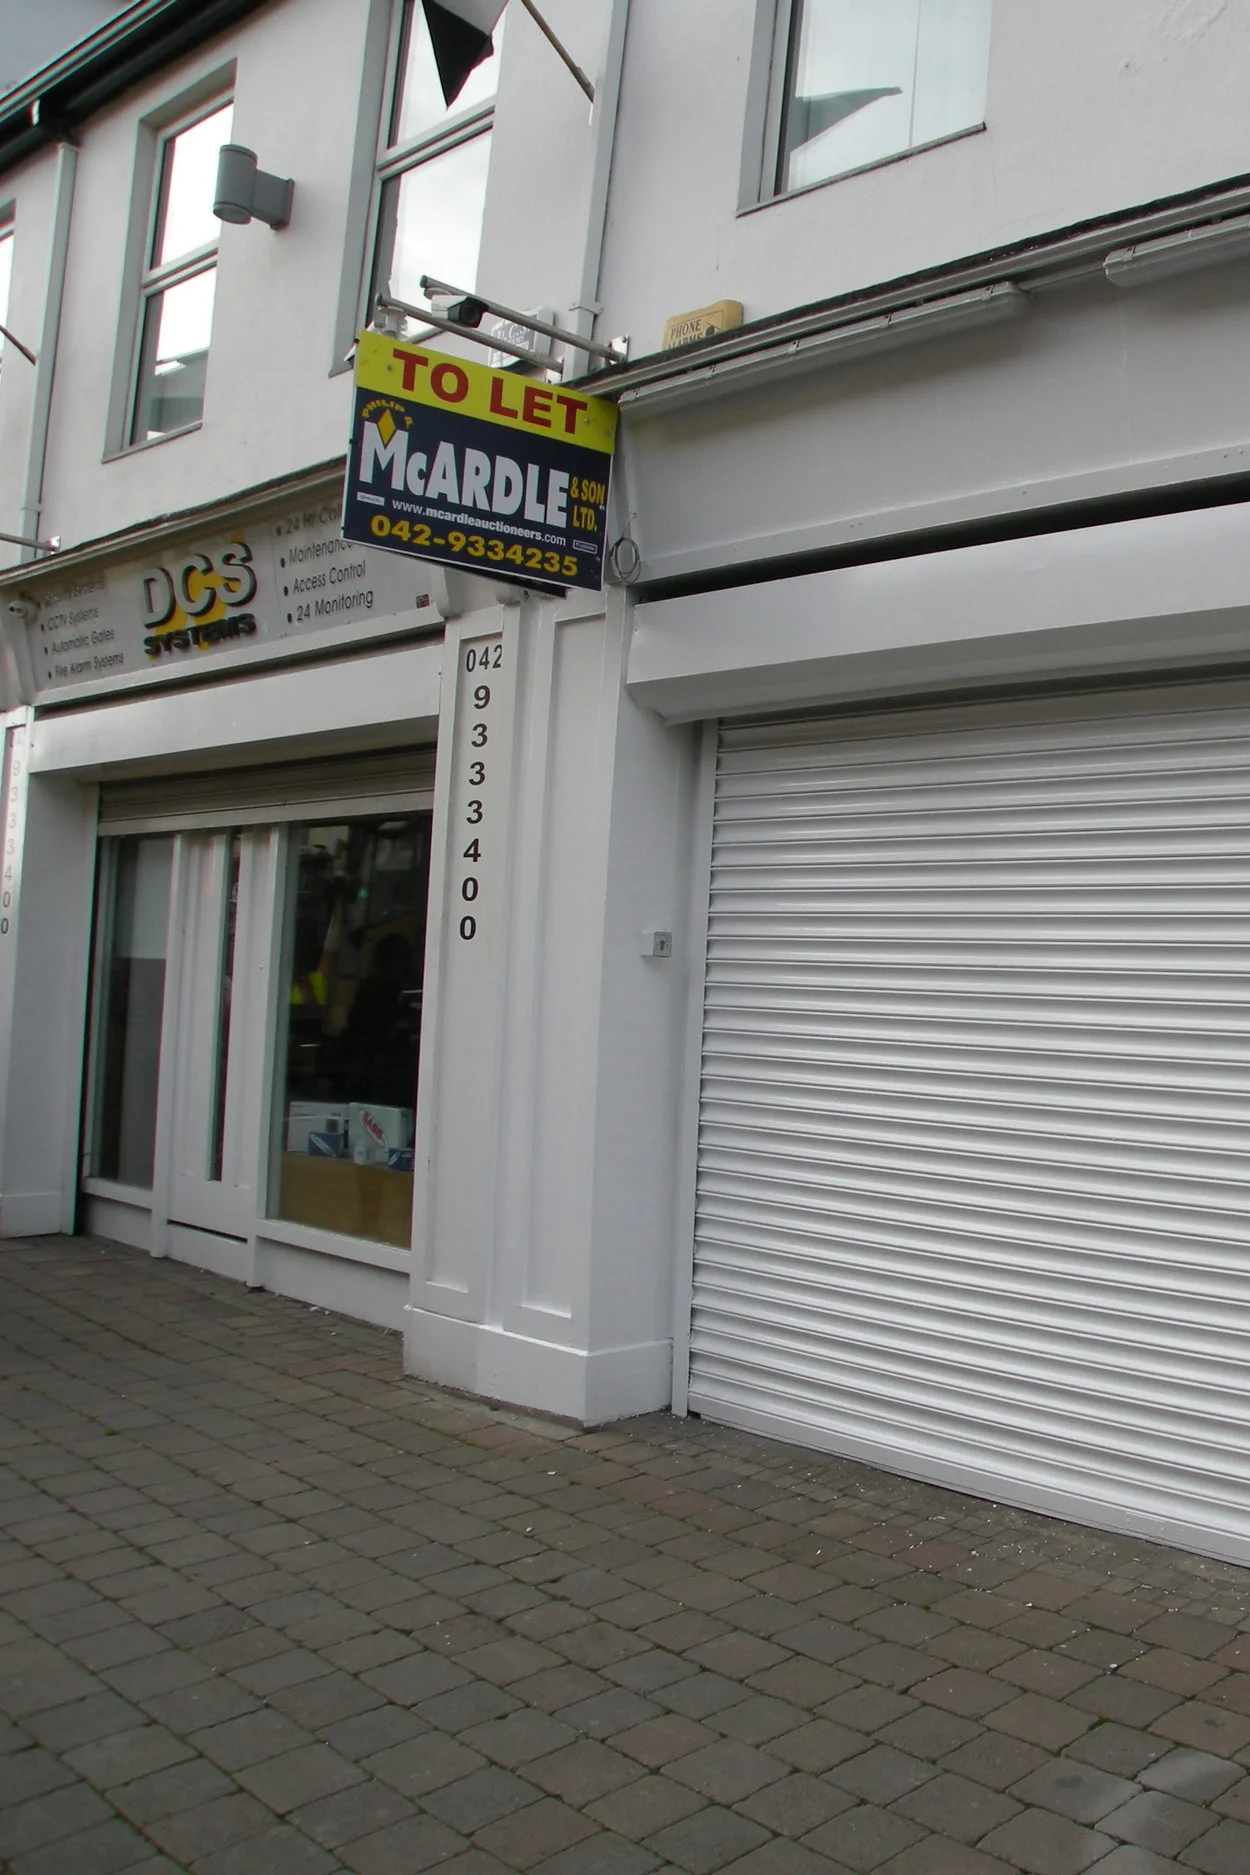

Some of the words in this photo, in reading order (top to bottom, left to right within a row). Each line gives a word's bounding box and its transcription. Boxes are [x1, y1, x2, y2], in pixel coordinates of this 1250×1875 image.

[670, 319, 702, 341] PHONE
[393, 348, 469, 403] TO
[489, 376, 588, 434] LET
[570, 476, 579, 499] &
[581, 479, 606, 505] SON
[392, 499, 566, 547] www.mcardleauctioneers.com
[572, 505, 597, 532] LTD.
[370, 514, 578, 577] 042-9334235
[141, 540, 258, 630] DCS
[292, 572, 326, 595] Access
[328, 559, 366, 585] Control
[47, 614, 67, 632] CCTV
[69, 606, 100, 626] Systems
[296, 604, 310, 623] 24
[315, 590, 374, 617] Monitoring
[52, 635, 89, 655] Automatic
[91, 628, 115, 645] Gates
[55, 665, 69, 678] Fire
[70, 660, 92, 674] Alarm
[93, 652, 124, 671] Systems
[466, 644, 503, 673] 042
